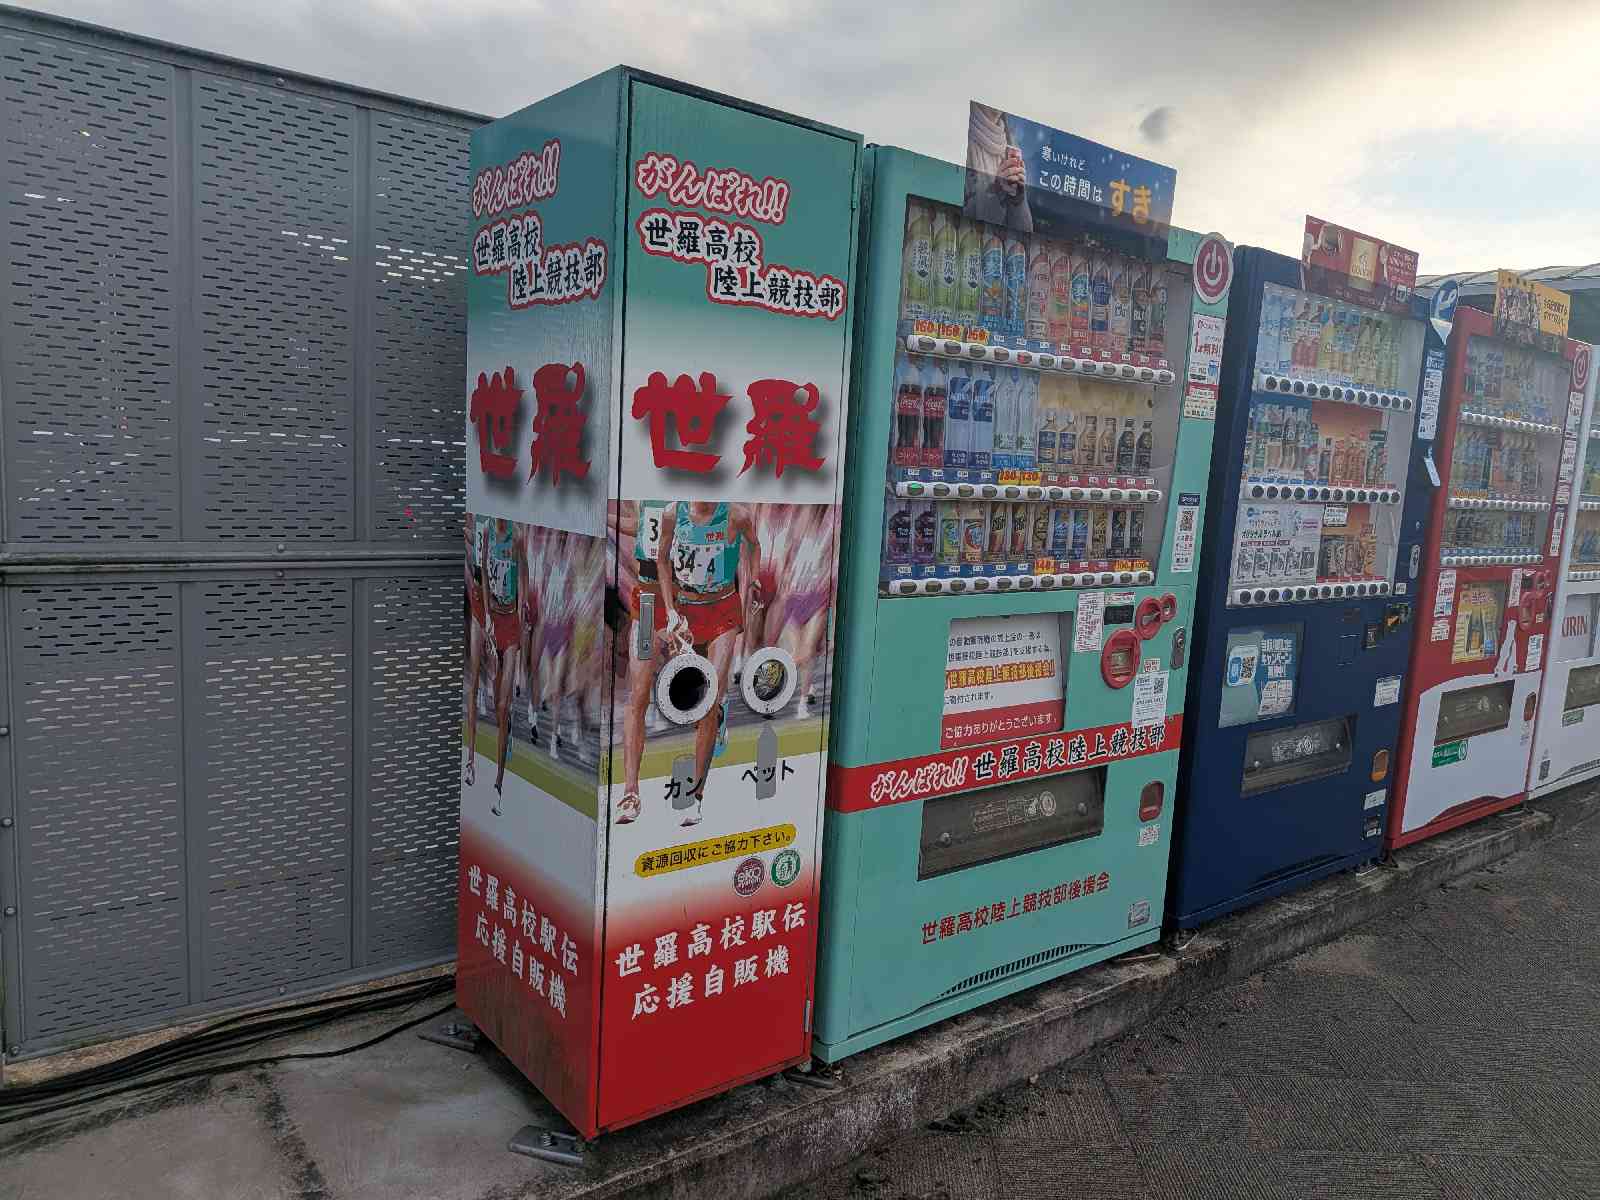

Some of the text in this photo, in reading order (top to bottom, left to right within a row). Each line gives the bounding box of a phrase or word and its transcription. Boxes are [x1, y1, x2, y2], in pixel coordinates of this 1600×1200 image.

[1041, 146, 1087, 171] 寒いけれど
[1039, 171, 1104, 202] この時間は
[475, 219, 541, 267] 世羅高校
[644, 218, 758, 266] 世羅高校
[511, 247, 604, 300] 陸上競技部
[713, 265, 842, 314] 陸上競技部
[470, 361, 592, 487] 世羅
[631, 371, 825, 479] 世羅
[741, 759, 795, 784] ペット
[973, 721, 1166, 780] 世羅高校陸上競技部
[663, 777, 703, 801] カン
[642, 831, 791, 873] 資源回収にご協力下さい。
[468, 864, 578, 977] 世羅高校駅伝
[920, 871, 1111, 945] 世羅高校陸上競技部後援会
[474, 910, 568, 1020] 応援自販機
[615, 901, 807, 980] 世羅高校駅伝
[631, 944, 790, 1021] 応援自販機
